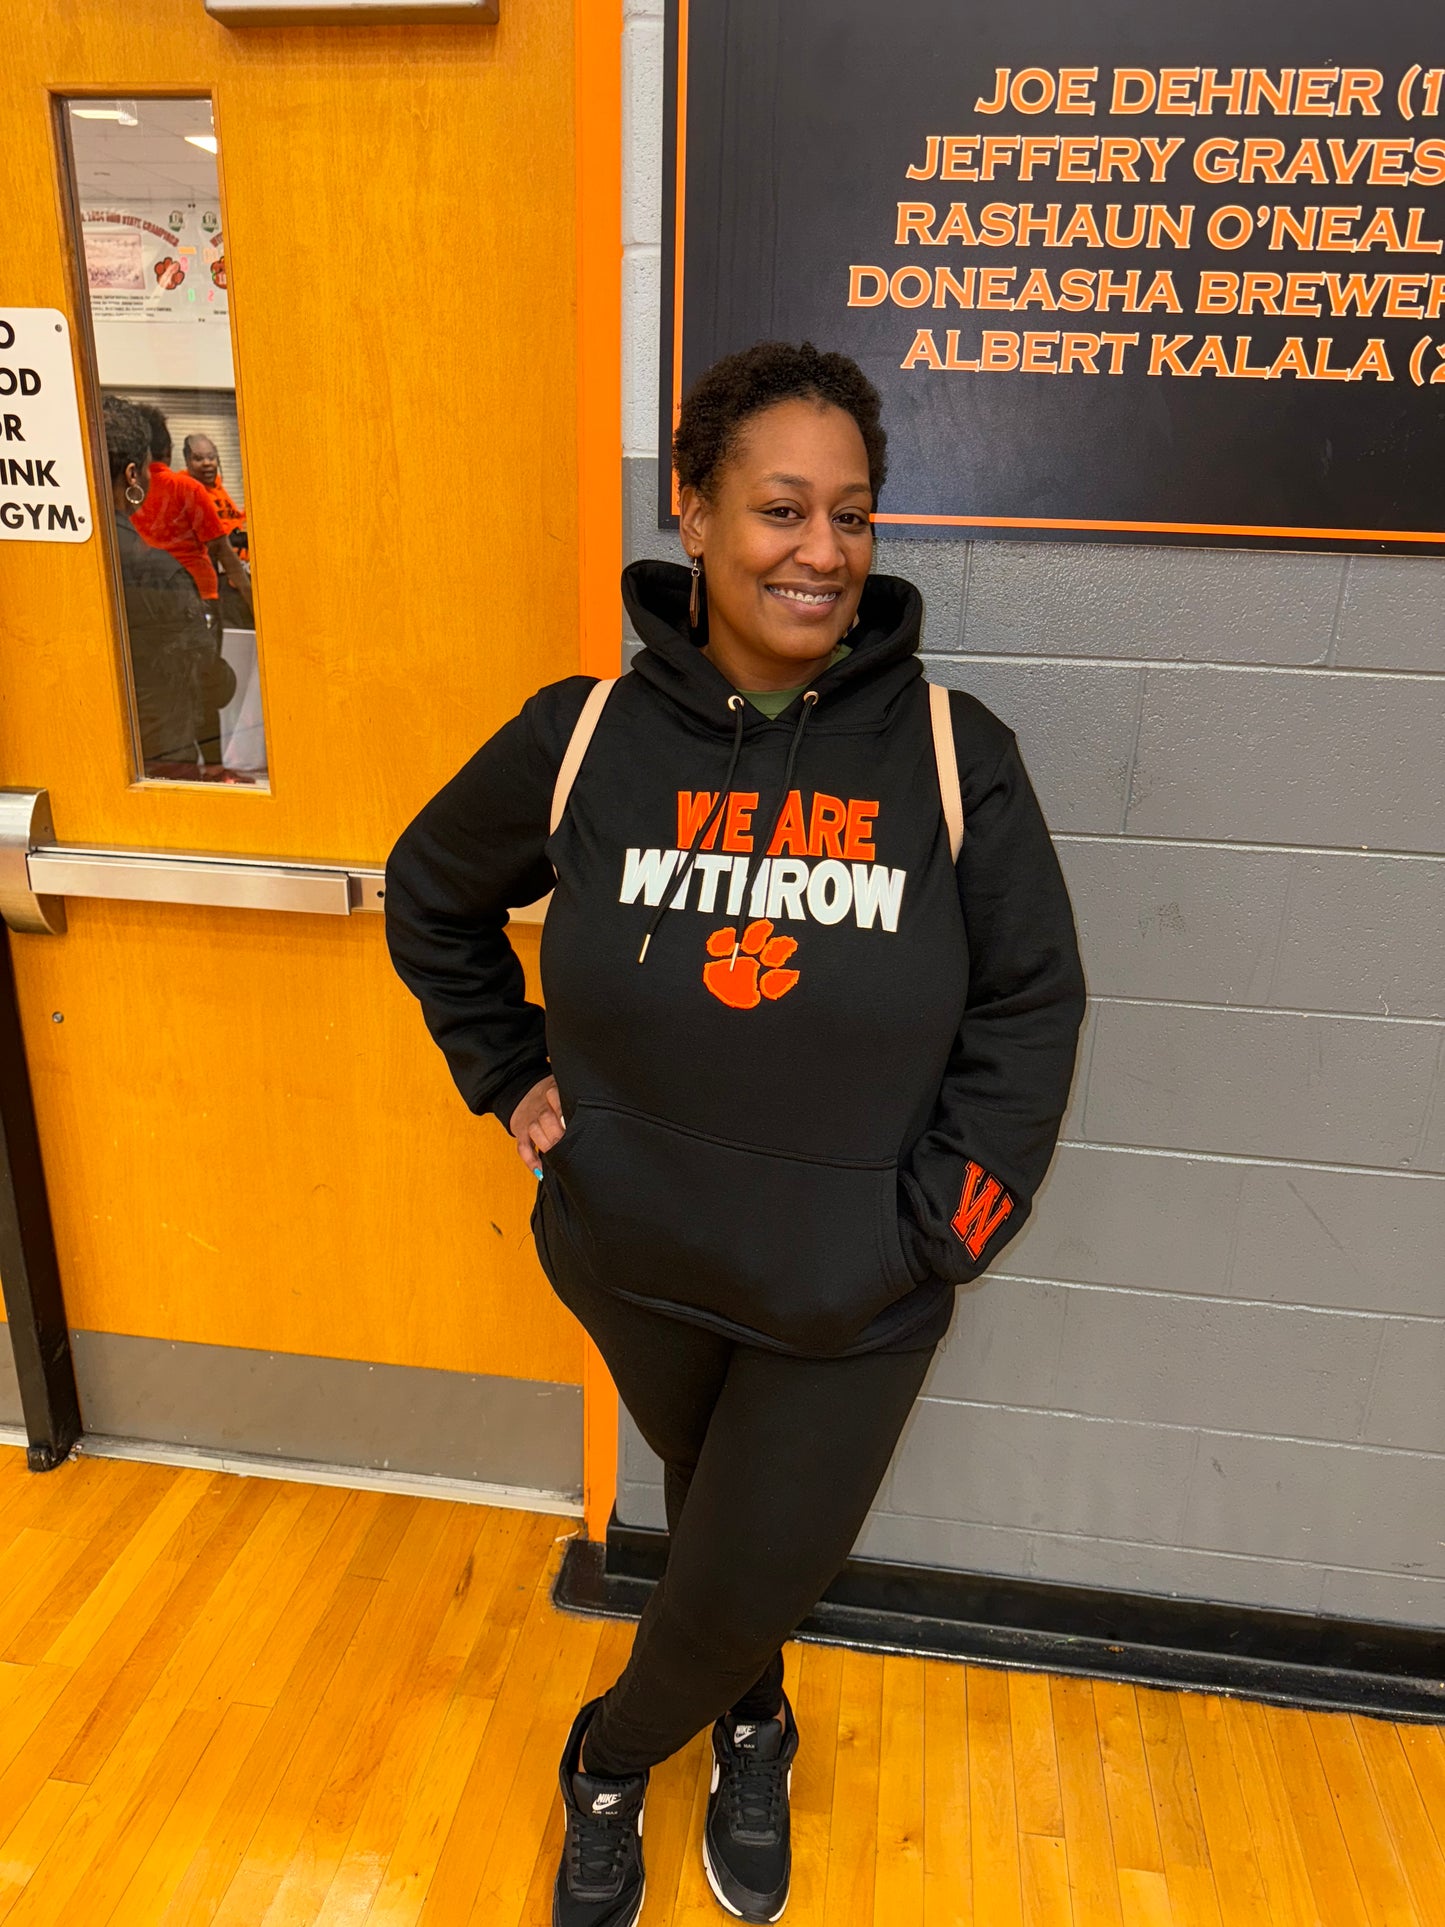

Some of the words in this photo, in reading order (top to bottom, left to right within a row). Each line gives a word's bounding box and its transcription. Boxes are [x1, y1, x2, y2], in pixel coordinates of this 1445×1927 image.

[974, 66, 1098, 117] JOE
[1109, 66, 1383, 117] DEHNER
[905, 135, 1185, 183] JEFFERY
[1193, 136, 1445, 187] GRAVES
[895, 202, 1195, 248] RASHAUN
[1207, 204, 1443, 254] O’NEAL
[847, 265, 1183, 313] DONEASHA
[900, 329, 1139, 375] ALBERT
[1147, 333, 1394, 382] KALALA
[0, 367, 42, 396] OD
[0, 413, 26, 442] R
[0, 458, 61, 488] INK
[0, 501, 79, 532] GYM
[677, 790, 760, 853] WE
[765, 789, 880, 861] ARE
[618, 847, 907, 933] WITHROW
[950, 1159, 1015, 1262] W
